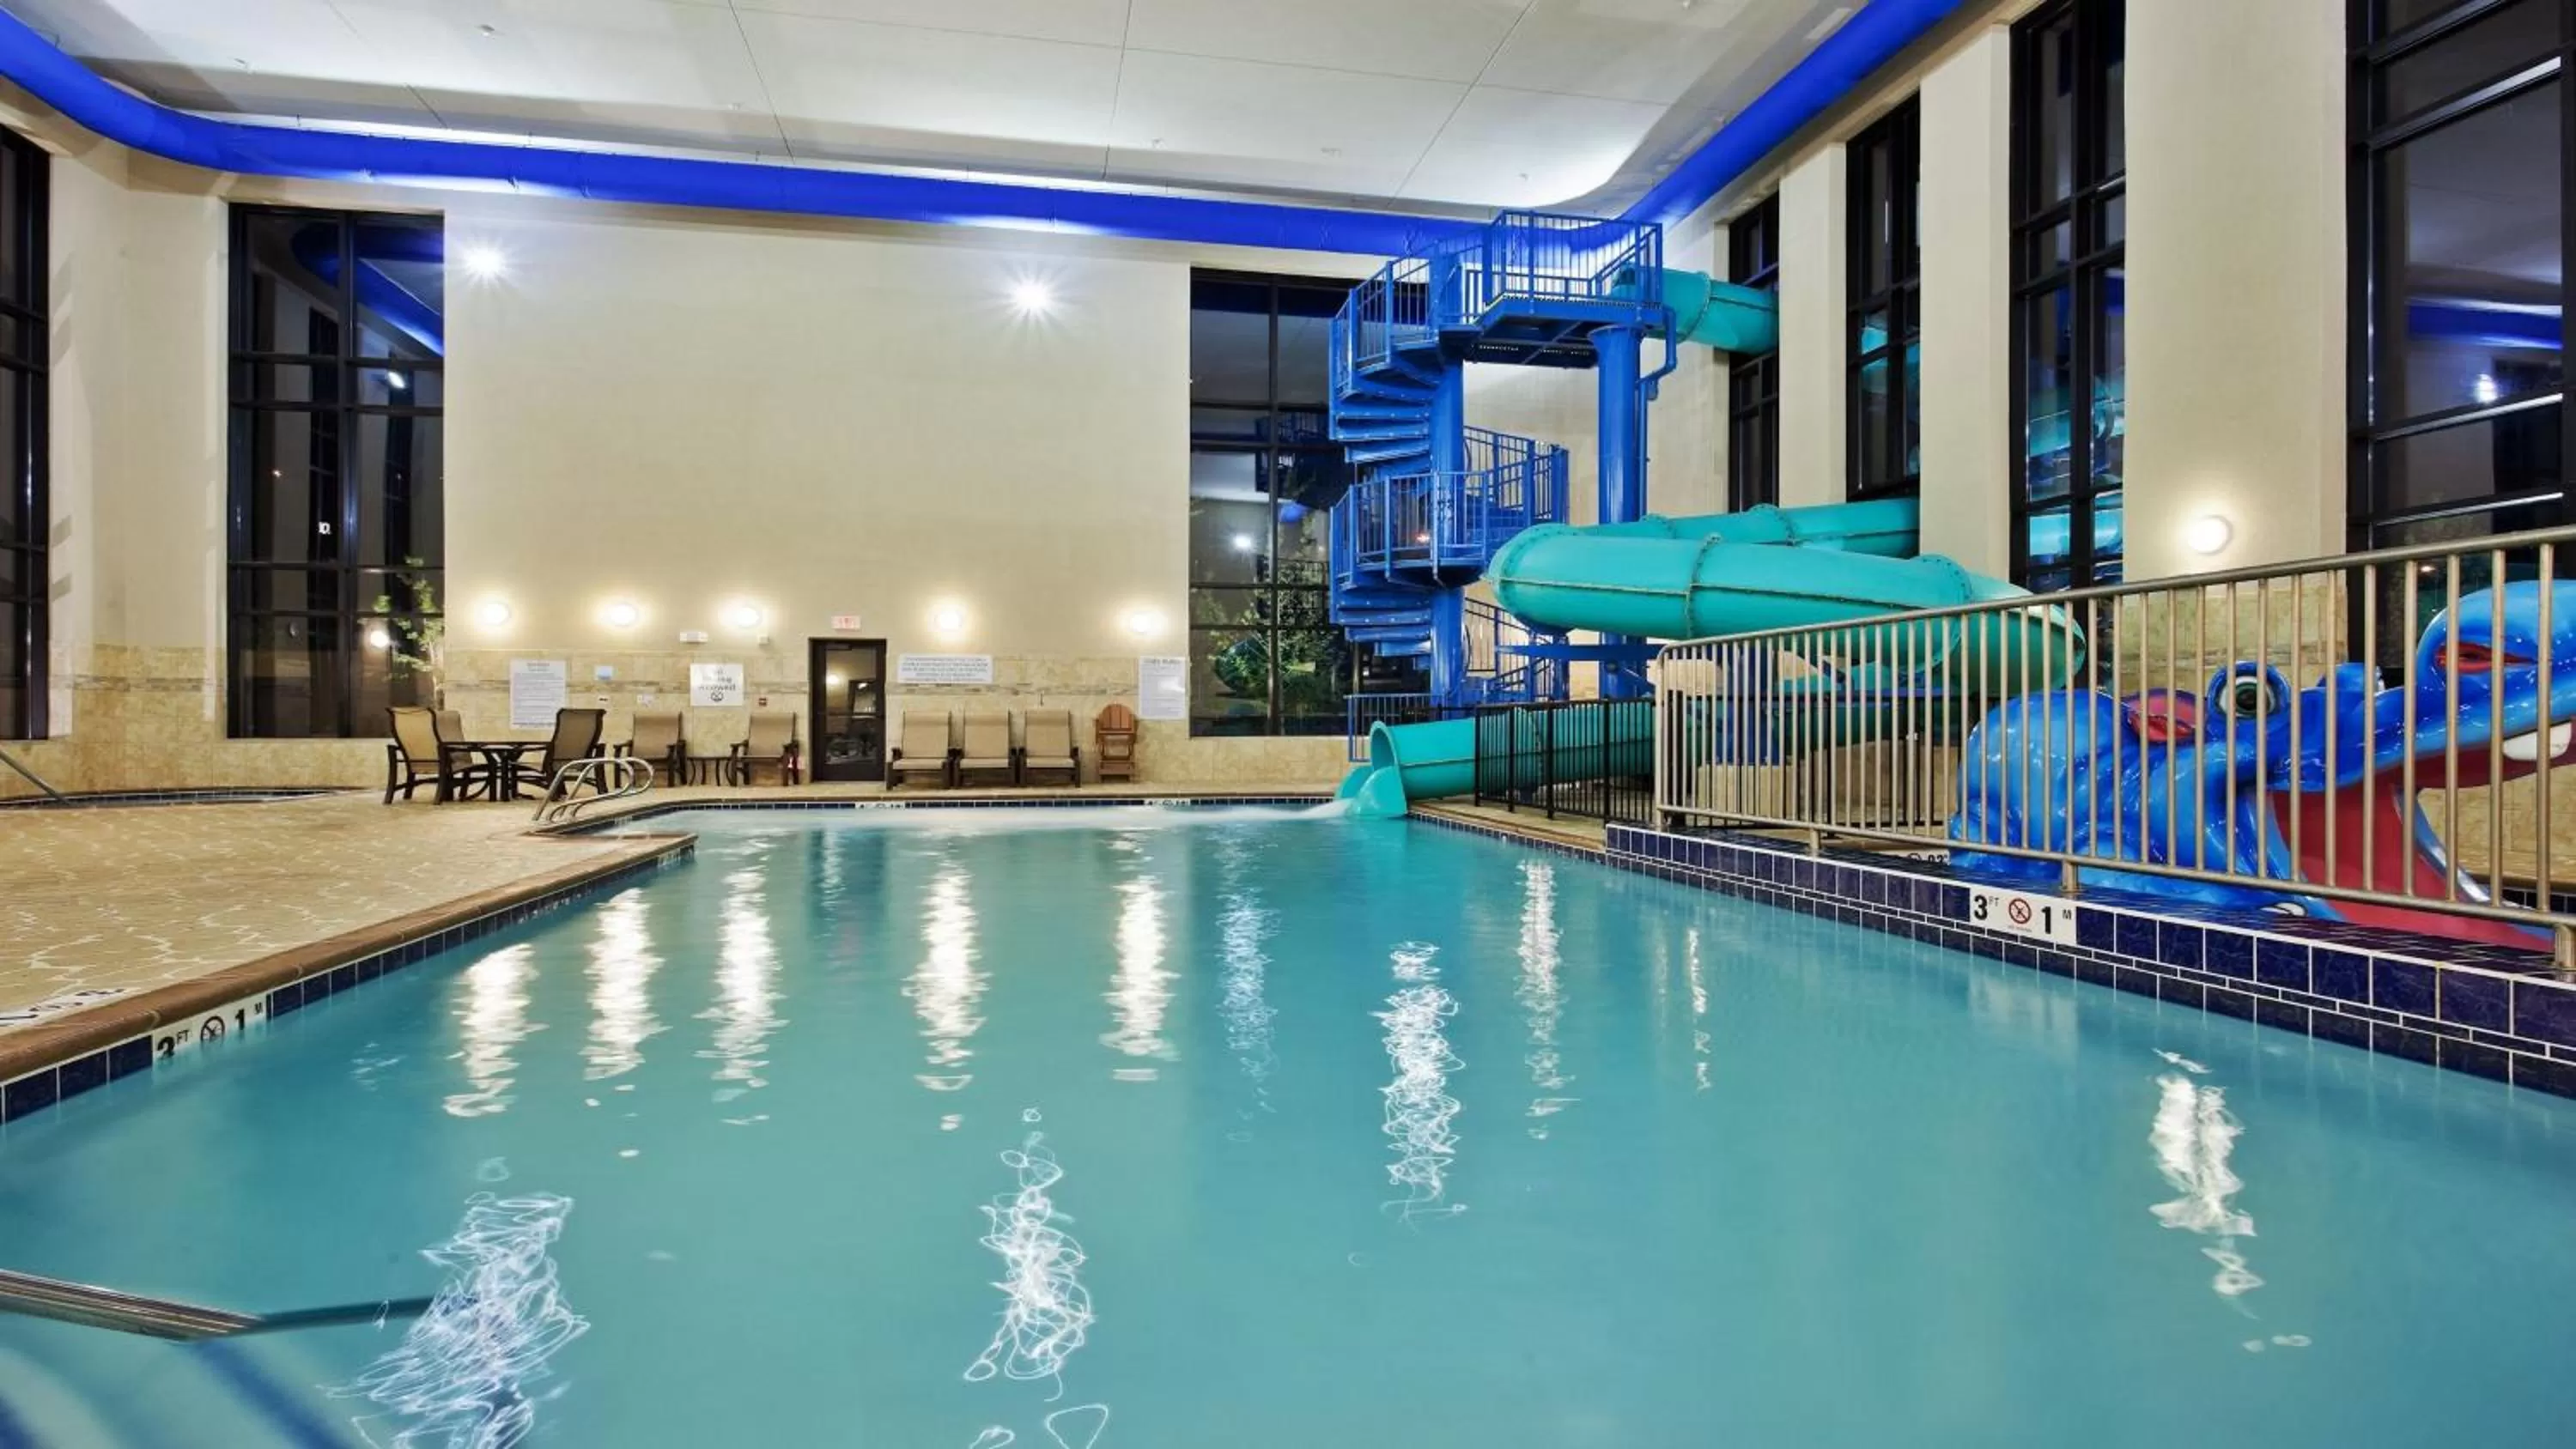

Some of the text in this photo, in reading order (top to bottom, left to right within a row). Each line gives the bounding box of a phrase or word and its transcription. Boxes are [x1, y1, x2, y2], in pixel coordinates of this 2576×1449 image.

[1974, 894, 1988, 920] 3
[1989, 895, 1999, 906] FT
[2041, 906, 2051, 935] 1
[2063, 908, 2072, 920] M
[176, 1029, 189, 1045] FT
[235, 1007, 245, 1031] 1
